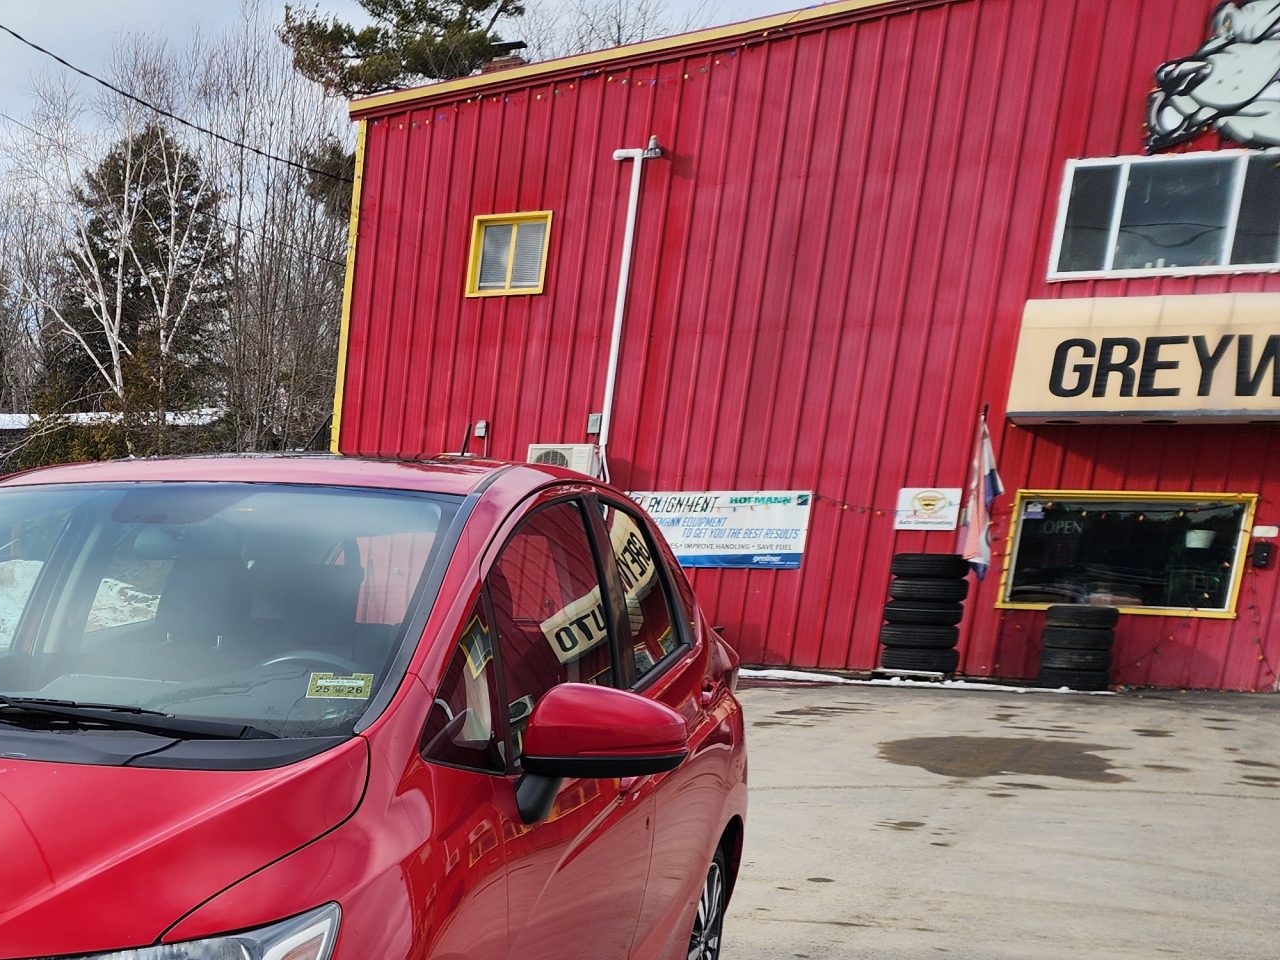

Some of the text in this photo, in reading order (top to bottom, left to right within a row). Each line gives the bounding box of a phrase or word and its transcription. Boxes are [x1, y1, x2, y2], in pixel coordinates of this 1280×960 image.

[646, 496, 720, 513] ALIGNMENT
[729, 496, 792, 505] HOFMANN
[682, 516, 728, 528] EQUIPMENT
[1043, 520, 1084, 534] OPEN
[682, 527, 801, 539] TO GET YOU THE BEST RESULTS
[715, 543, 750, 551] HANDLING
[756, 543, 774, 551] SAVE
[315, 685, 331, 693] 25
[346, 686, 363, 694] 26
